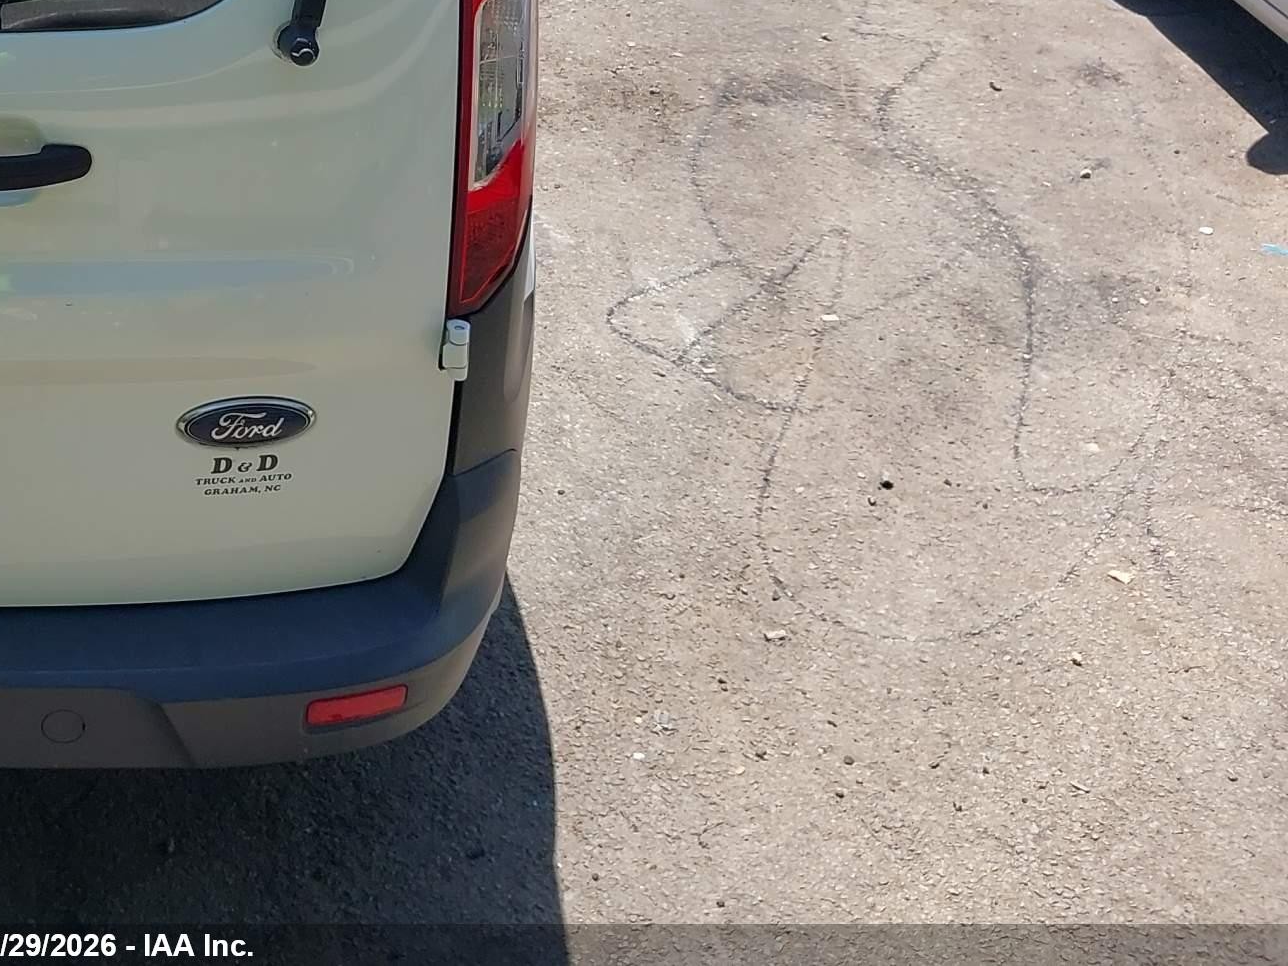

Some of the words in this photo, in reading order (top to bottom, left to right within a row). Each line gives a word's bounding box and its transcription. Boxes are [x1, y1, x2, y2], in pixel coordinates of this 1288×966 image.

[211, 412, 285, 440] Ford
[210, 457, 233, 475] D
[237, 462, 253, 473] &
[256, 454, 279, 472] D
[195, 477, 236, 486] TRUCK
[259, 473, 292, 483] AUTO
[204, 486, 262, 496] GRAHAM,
[264, 484, 282, 492] NC
